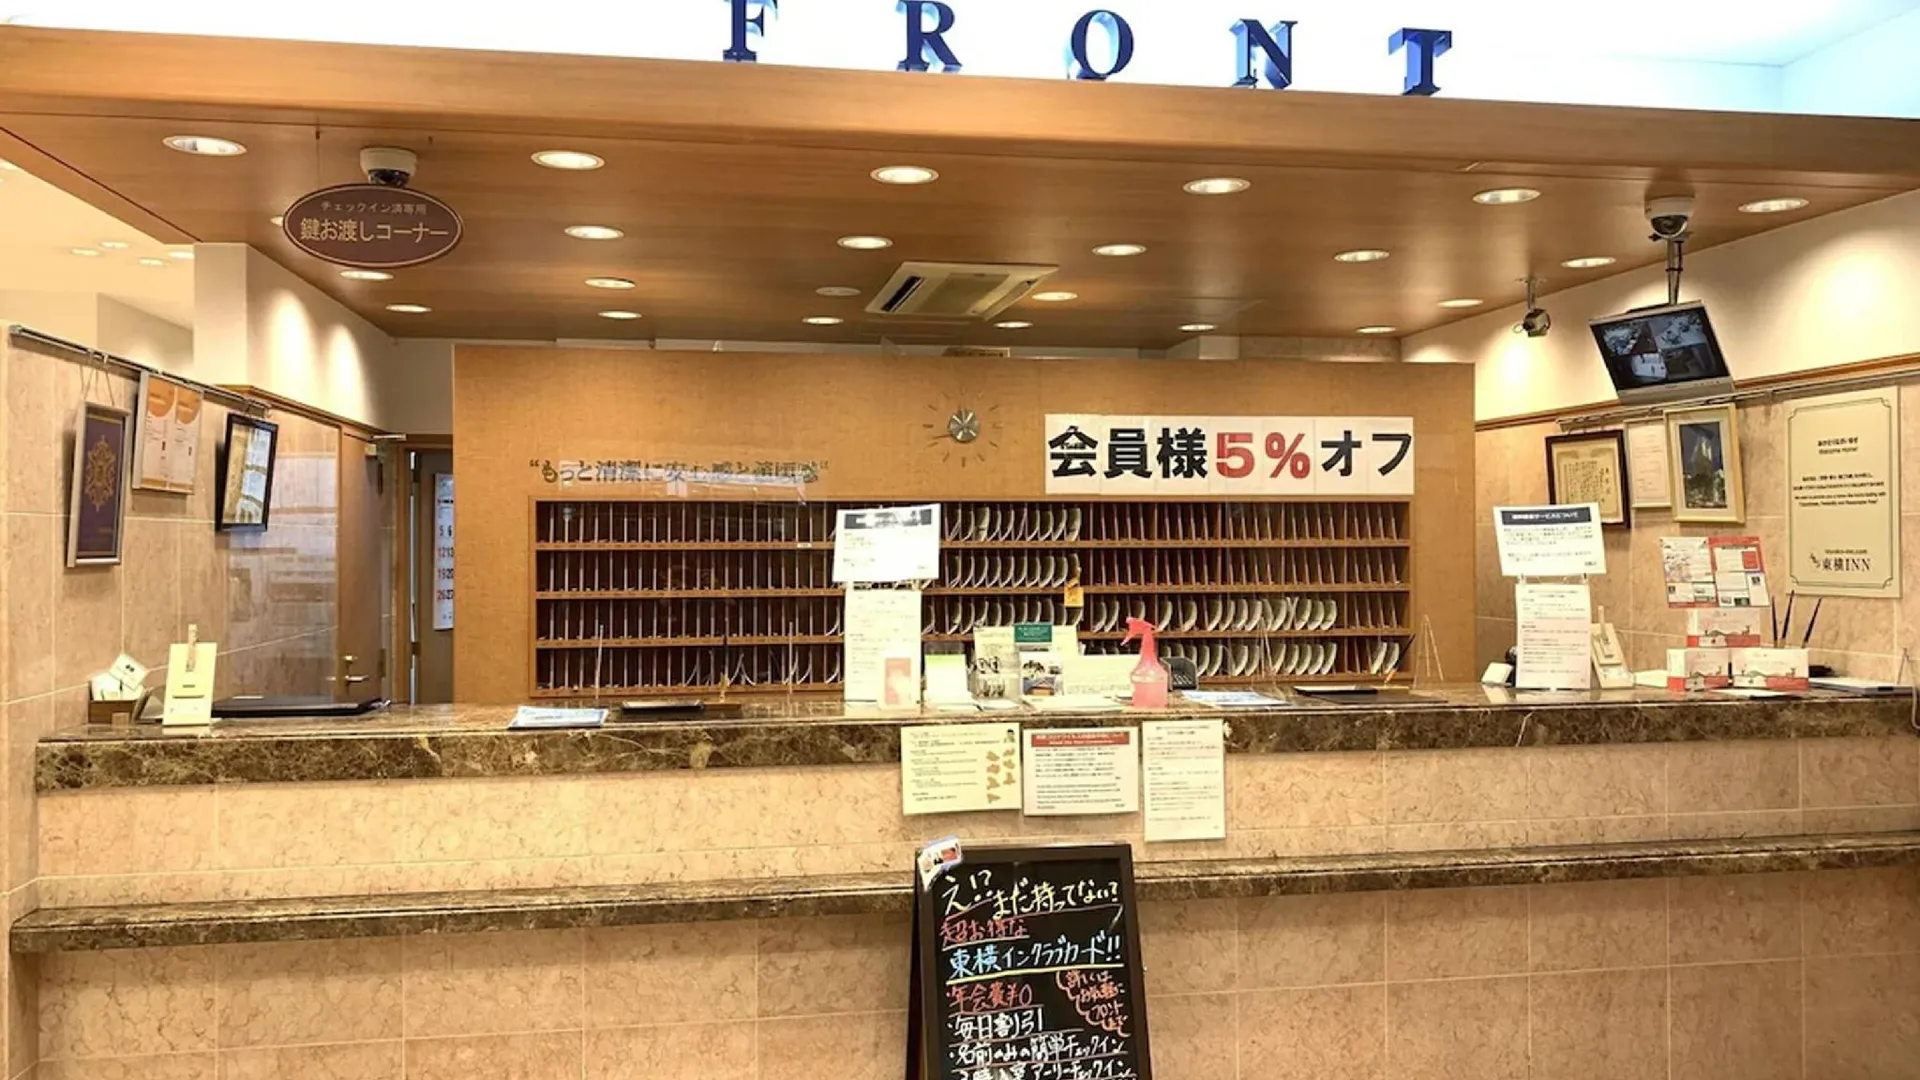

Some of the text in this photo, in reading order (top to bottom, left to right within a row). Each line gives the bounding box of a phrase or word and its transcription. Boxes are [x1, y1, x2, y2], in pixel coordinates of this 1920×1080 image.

[721, 0, 1453, 97] FRONT
[321, 201, 427, 216] チェックイン済専用
[300, 217, 449, 243] 鍵お渡しコーナー
[1047, 425, 1412, 479] 会員様5%オフ
[940, 919, 1029, 946] 超お得な
